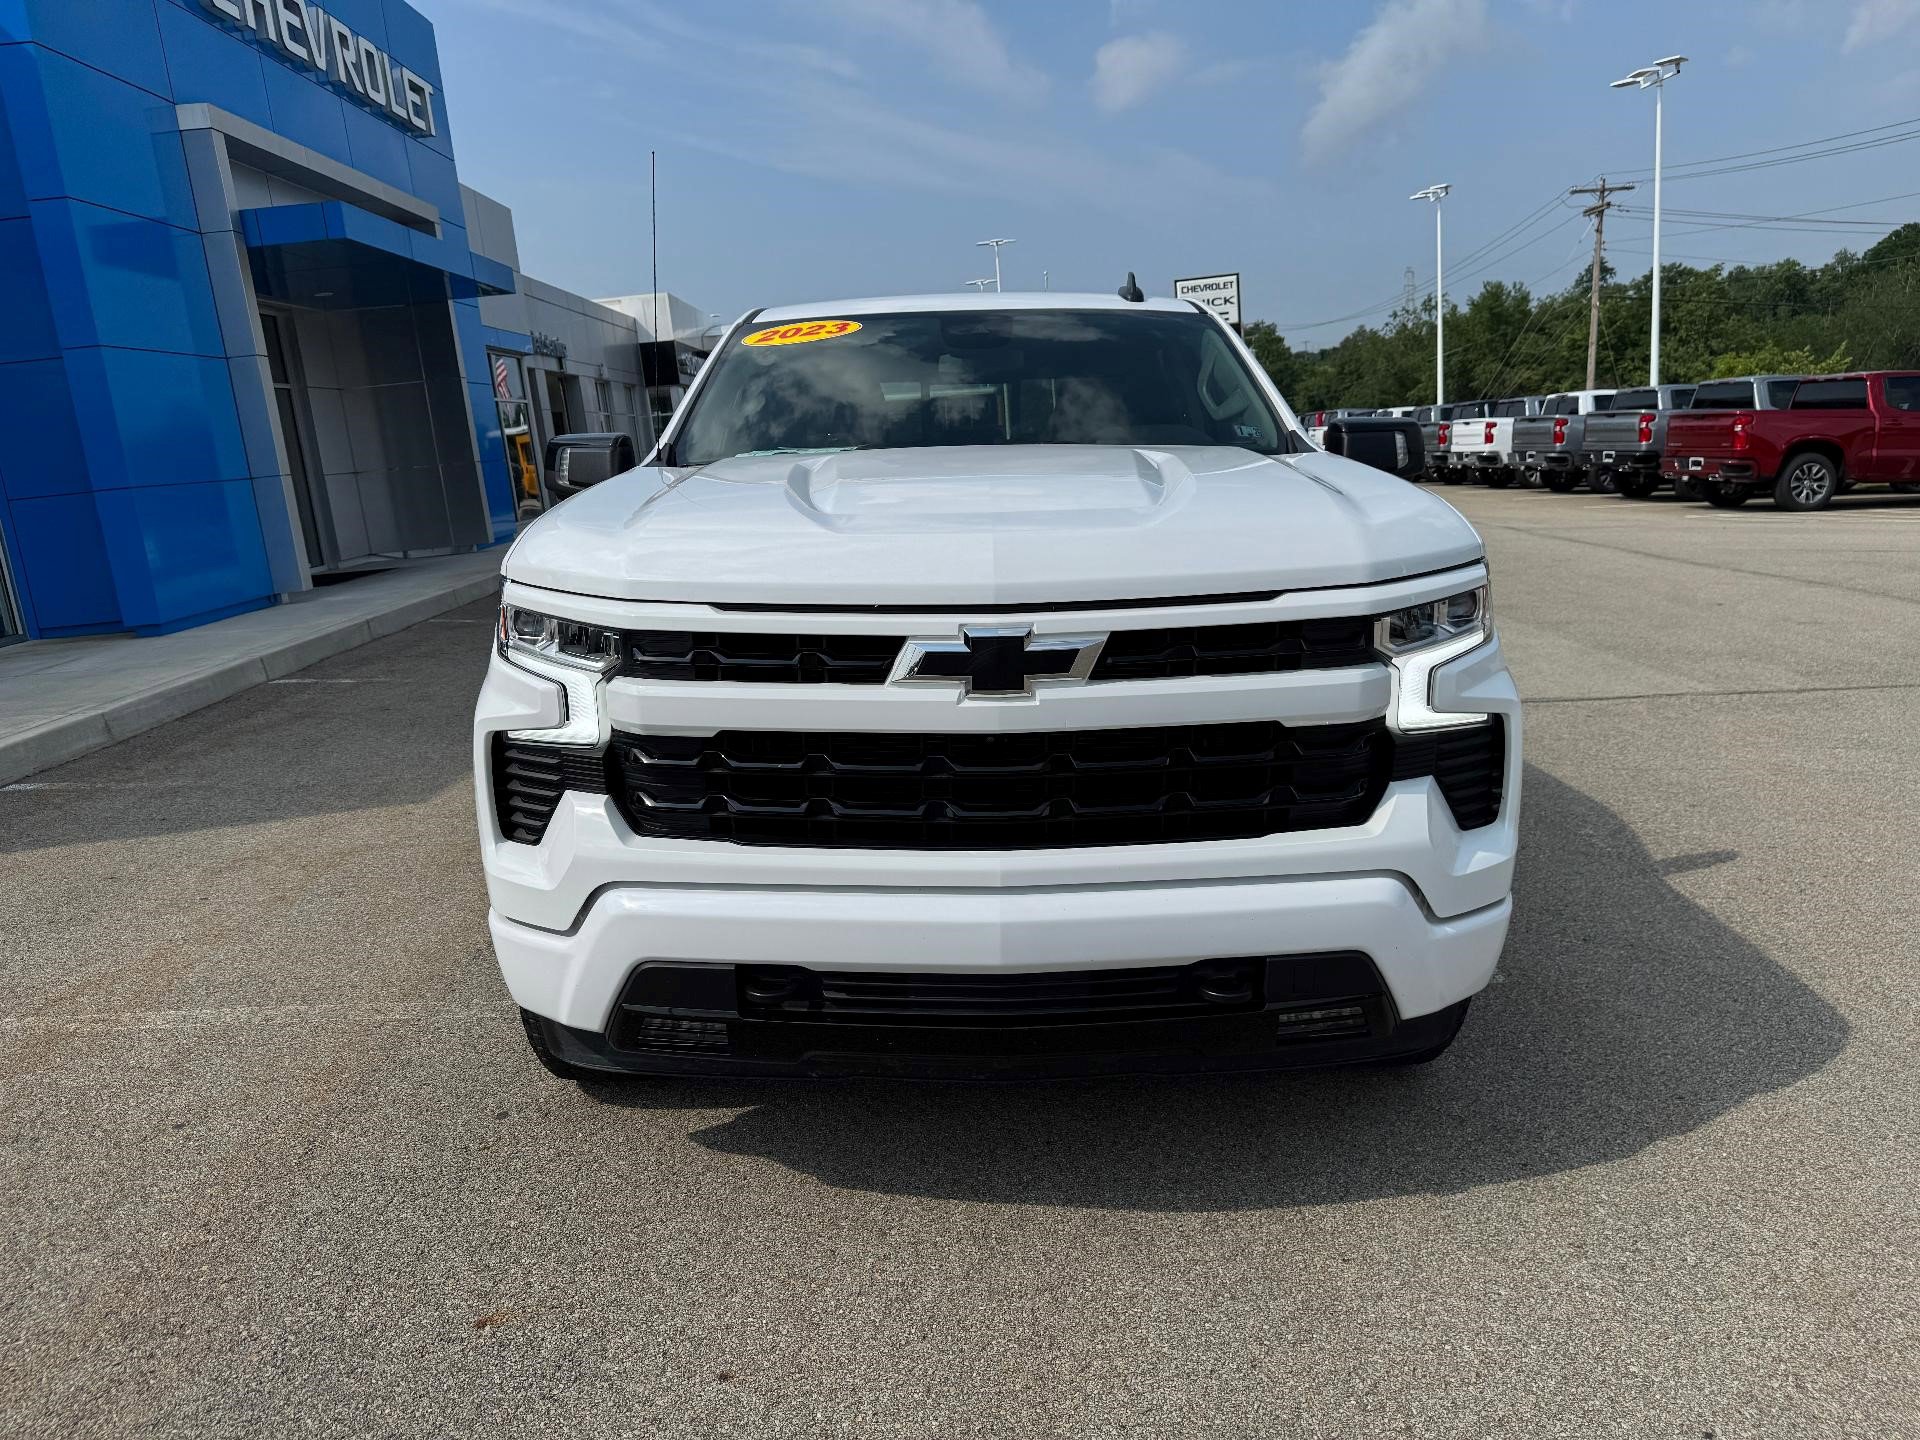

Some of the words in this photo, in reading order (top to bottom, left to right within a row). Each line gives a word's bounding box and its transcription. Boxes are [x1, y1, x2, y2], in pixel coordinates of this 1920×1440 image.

[1181, 281, 1234, 294] CHEVROLET
[1202, 296, 1235, 306] ICK
[753, 323, 851, 343] 2023
